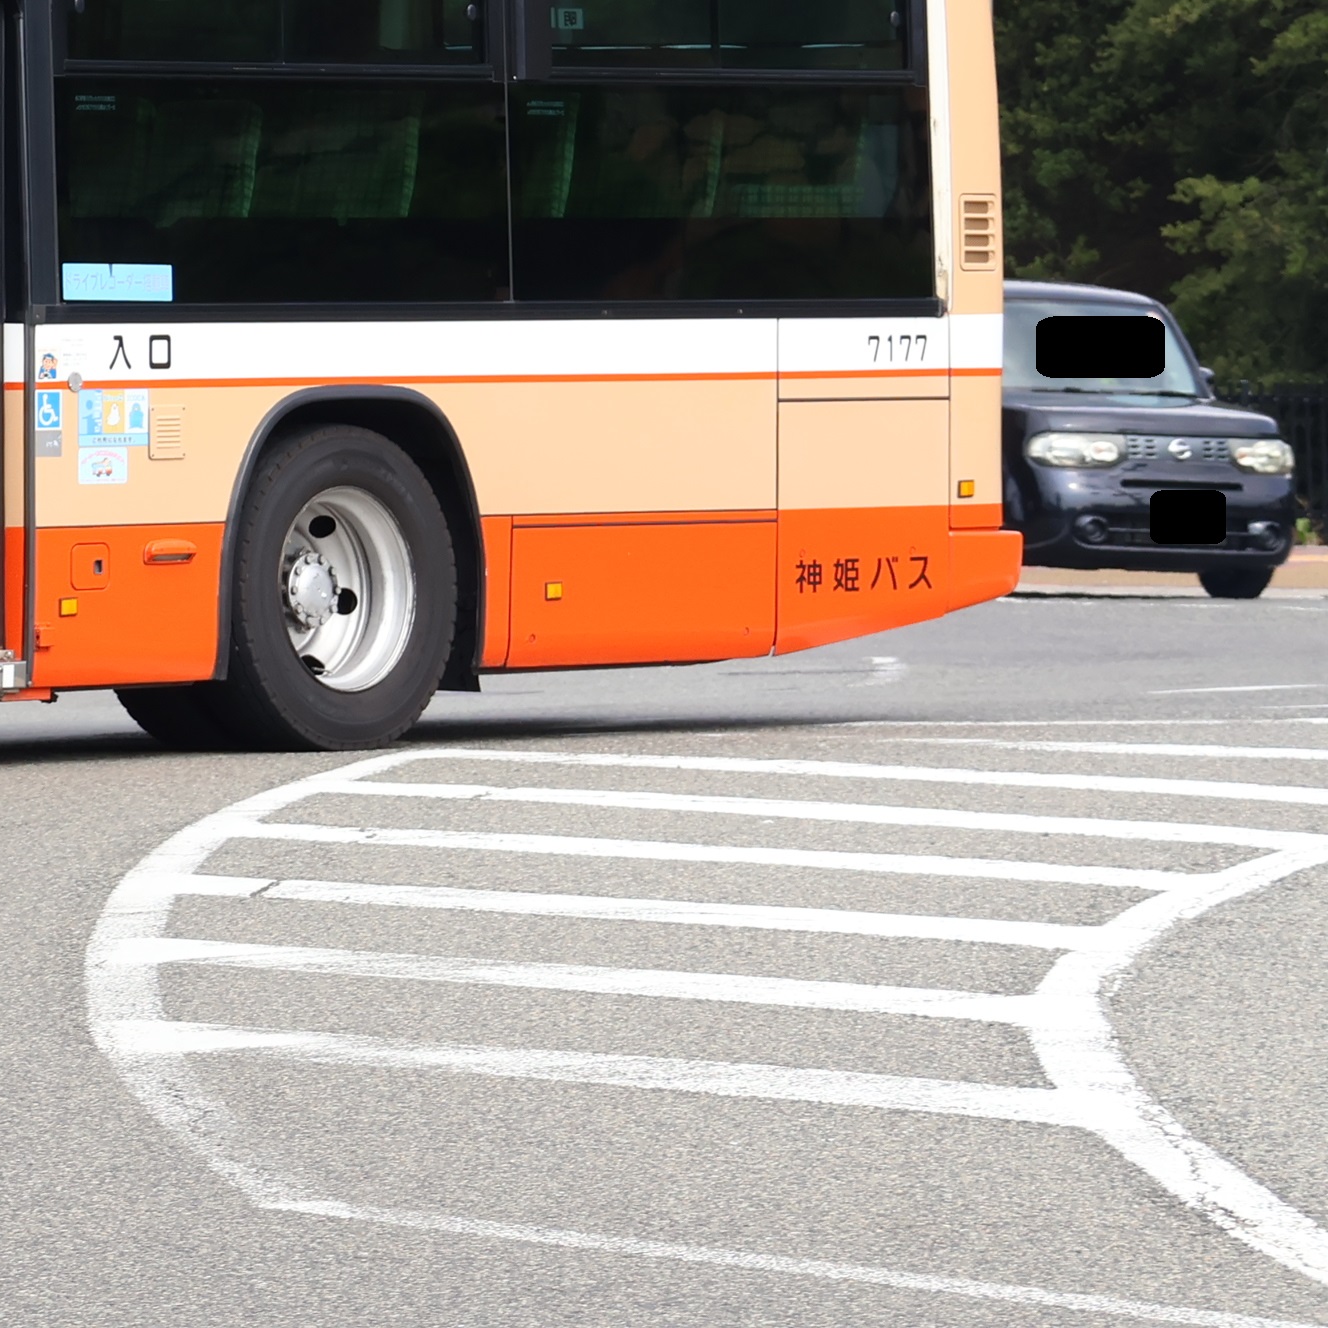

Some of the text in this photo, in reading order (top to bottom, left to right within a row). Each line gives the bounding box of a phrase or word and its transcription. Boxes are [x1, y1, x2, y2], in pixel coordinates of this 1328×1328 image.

[109, 334, 171, 370] 入口
[867, 334, 928, 362] 7177
[794, 555, 932, 595] 神姫バス
